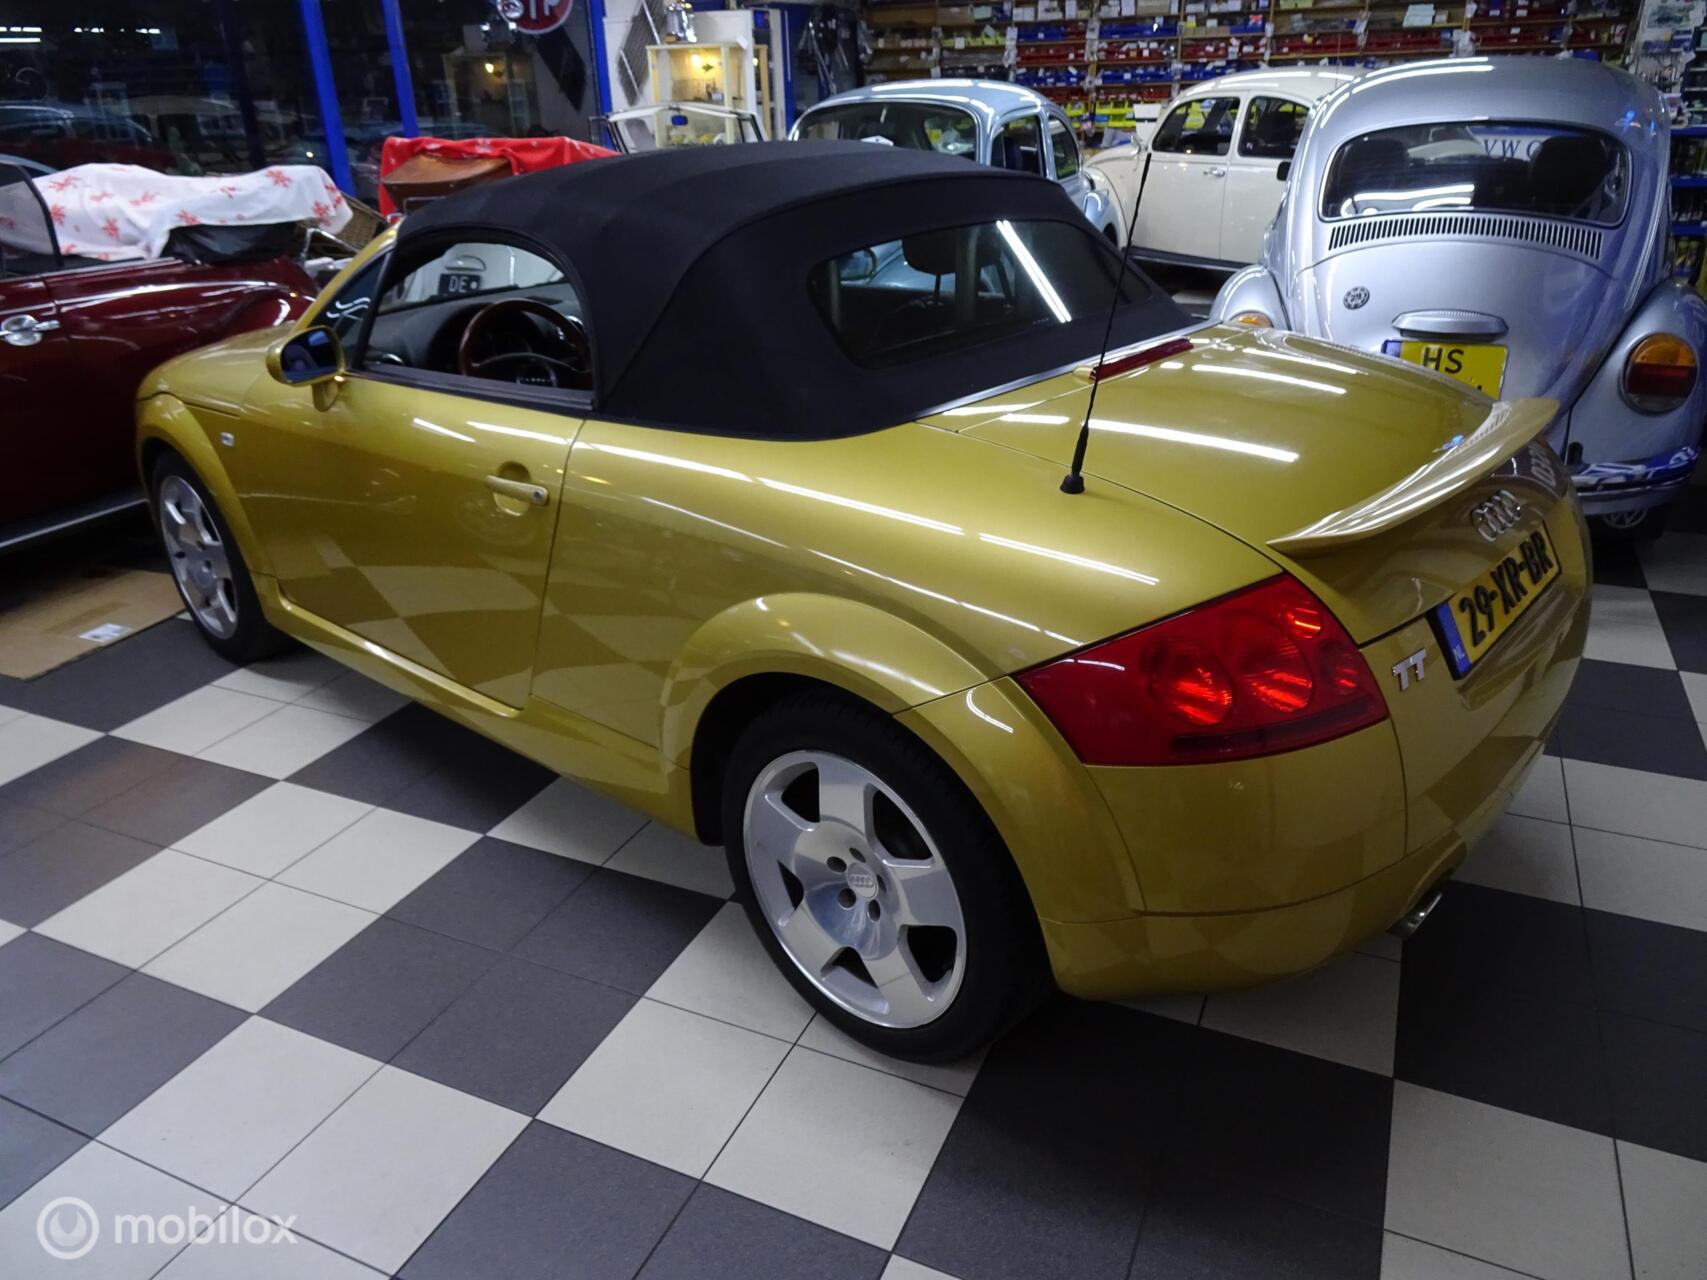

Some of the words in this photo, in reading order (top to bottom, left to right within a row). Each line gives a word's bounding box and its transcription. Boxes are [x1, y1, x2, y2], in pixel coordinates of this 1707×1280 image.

[1422, 347, 1465, 375] HS
[1459, 530, 1554, 648] 29-XR-BR
[1392, 648, 1427, 690] TT
